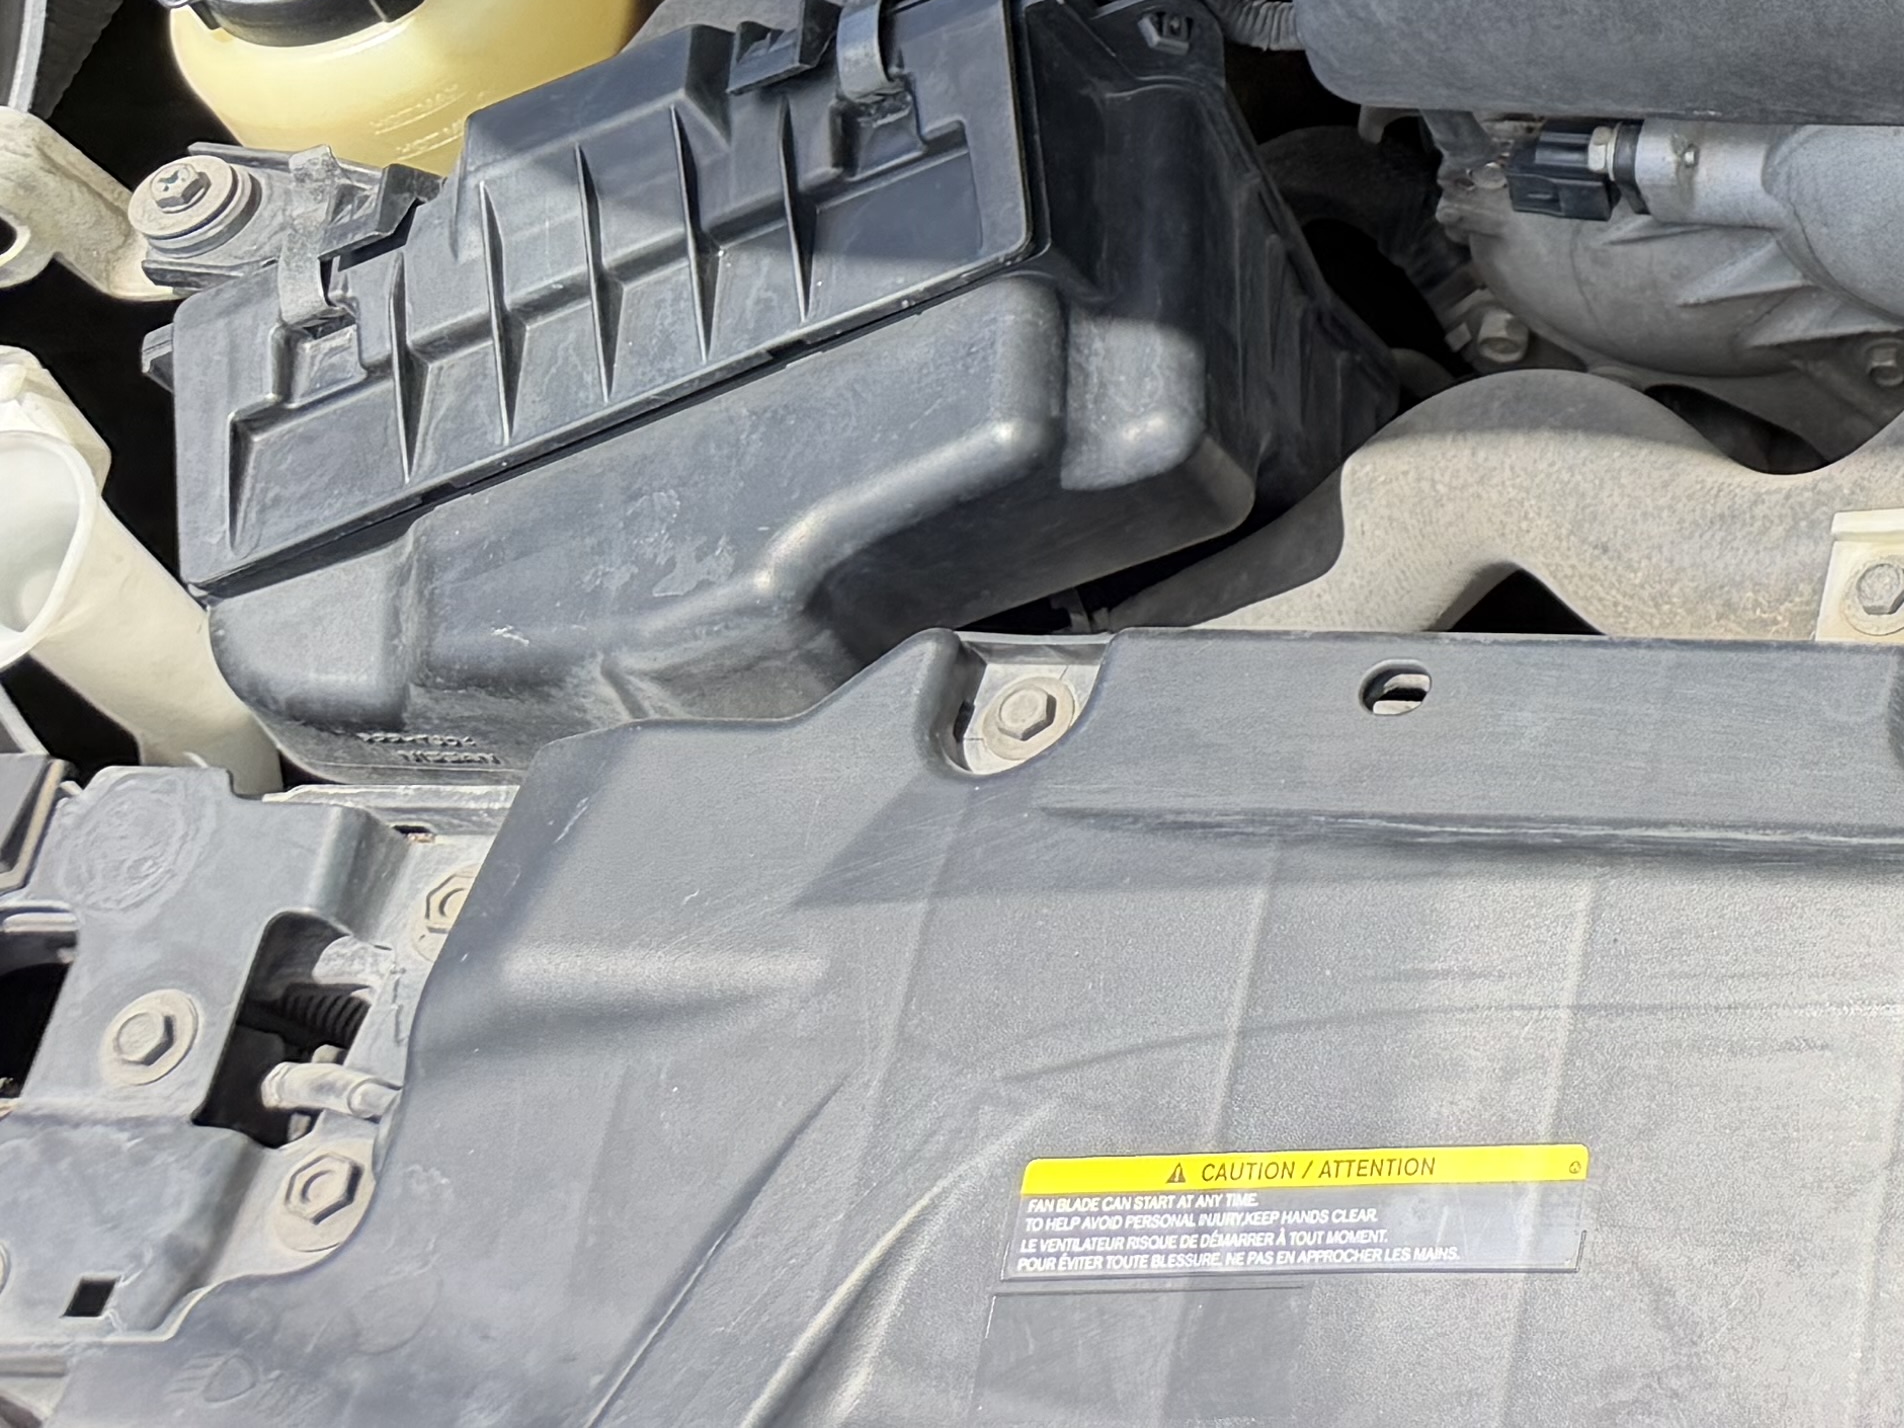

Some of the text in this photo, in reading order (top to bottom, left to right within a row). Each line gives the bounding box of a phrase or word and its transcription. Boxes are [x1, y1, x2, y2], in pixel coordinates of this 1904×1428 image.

[397, 750, 502, 765] NISSAN
[1200, 1160, 1295, 1180] CAUTION
[1318, 1156, 1436, 1178] ATTENTION
[1028, 1198, 1054, 1212] FAN
[1056, 1197, 1100, 1212] BLADE
[1102, 1196, 1130, 1211] CAN
[1134, 1195, 1174, 1210] START
[1178, 1195, 1192, 1209] AT
[1195, 1194, 1223, 1209] ANY
[1025, 1217, 1044, 1232] TO
[1046, 1216, 1080, 1231] HELP
[1082, 1215, 1122, 1230] AVOID
[1124, 1214, 1196, 1229] PERSONAL
[1281, 1211, 1328, 1226] HANDS
[1021, 1235, 1037, 1250] LE
[1039, 1233, 1124, 1249] VENTILATEUR
[1126, 1232, 1176, 1247] RISQUE
[1180, 1232, 1198, 1246] DE
[1288, 1229, 1324, 1244] TOUT
[1018, 1254, 1056, 1270] POUR
[1104, 1252, 1149, 1268] TOUTE
[1224, 1250, 1246, 1266] NE
[1248, 1250, 1274, 1265] PAS
[1277, 1249, 1297, 1264] EN
[1299, 1247, 1382, 1264] APPROCHER
[1385, 1247, 1410, 1262] LES
